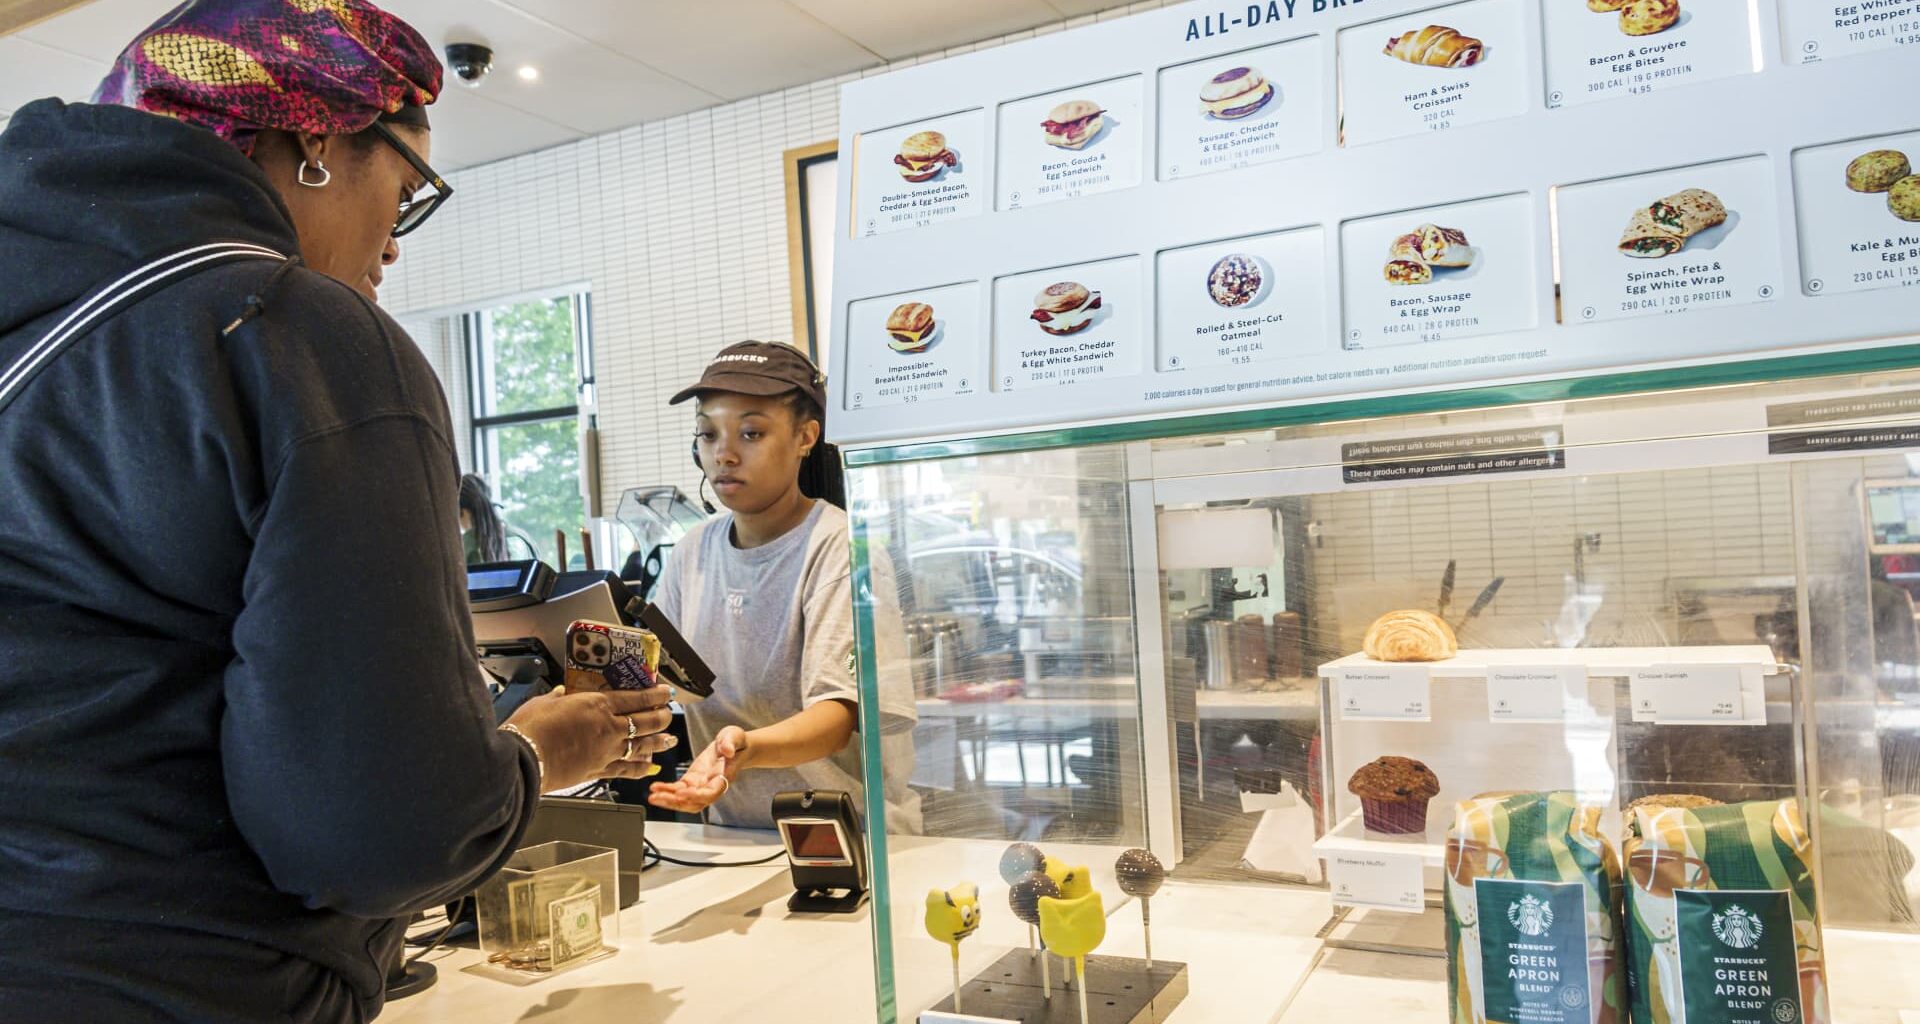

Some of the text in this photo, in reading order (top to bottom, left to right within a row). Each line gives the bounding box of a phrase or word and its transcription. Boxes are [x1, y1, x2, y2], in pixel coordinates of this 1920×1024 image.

[1835, 6, 1858, 16] Egg
[1835, 7, 1911, 28] Red Pepper
[1186, 0, 1296, 42] ALL-DAY
[1849, 21, 1919, 42] 170 CAL 12 G
[1589, 53, 1624, 66] Bacon
[1628, 49, 1636, 58] &
[1612, 56, 1665, 73] Egg Bites
[1588, 65, 1692, 92] 300 CAL 19 G PROTEIN
[1405, 81, 1470, 102] Ham & Swiss
[1413, 94, 1462, 111] Croissant
[1441, 109, 1455, 118] CAL
[1198, 121, 1279, 144] Sausage, Cheddar
[1204, 132, 1275, 153] & Egg Sandwich
[1042, 162, 1069, 172] Bacon,
[1071, 155, 1098, 165] Gouda
[1046, 164, 1102, 181] Egg Sandwich
[880, 201, 910, 212] Cheddar
[919, 199, 932, 207] Egg
[933, 191, 970, 203] Sandwich
[882, 183, 967, 203] Double-Smoked Bacon,
[1851, 241, 1880, 252] Kale
[1884, 238, 1893, 248] &
[1881, 251, 1905, 263] Egg
[1627, 261, 1721, 281] Spinach, Feta &
[1854, 266, 1919, 283] 230 CAL 15
[1626, 275, 1725, 295] Egg White Wrap
[1390, 292, 1471, 307] Bacon, Sausage
[1622, 290, 1732, 311] 290 CAL 20 G PROTEIN
[1400, 305, 1461, 317] & Egg Wrap
[1196, 314, 1283, 334] Rolled & Steel-Cut
[1401, 323, 1415, 332] CAL
[1445, 317, 1479, 328] PROTEIN
[1221, 328, 1261, 342] Oatmeal
[1021, 341, 1115, 358] Turkey Bacon, Cheddar
[1250, 342, 1263, 351] CAL
[1030, 360, 1045, 369] Egg
[1046, 356, 1072, 365] White
[1073, 351, 1114, 362] Sandwich
[875, 368, 948, 385] Breakfast Sandwich
[1045, 371, 1056, 379] CAL
[1077, 365, 1104, 375] PROTEIN
[1162, 389, 1186, 399] calories
[1191, 387, 1203, 396] day
[1204, 386, 1210, 394] is
[1210, 384, 1226, 393] used
[1227, 383, 1236, 391] for
[1237, 381, 1262, 392] general
[1262, 378, 1291, 388] nutrition
[1316, 373, 1328, 382] but
[1329, 370, 1352, 380] calorie
[1354, 368, 1375, 377] needs
[1393, 362, 1429, 373] Additional
[1430, 359, 1462, 369] nutrition
[1463, 355, 1495, 366] available
[1497, 353, 1517, 363] upon
[890, 387, 900, 395] CAL
[920, 381, 943, 391] PROTEIN
[1350, 470, 1371, 478] These
[1373, 467, 1407, 478] products
[1408, 466, 1425, 475] may
[1426, 463, 1456, 473] contain
[1458, 462, 1476, 470] nuts
[1477, 460, 1493, 469] and
[1495, 458, 1516, 467] other
[1509, 954, 1557, 967] GREEN
[1508, 969, 1560, 981] APRON
[1715, 969, 1768, 981] GREEN
[1714, 985, 1771, 996] APRON
